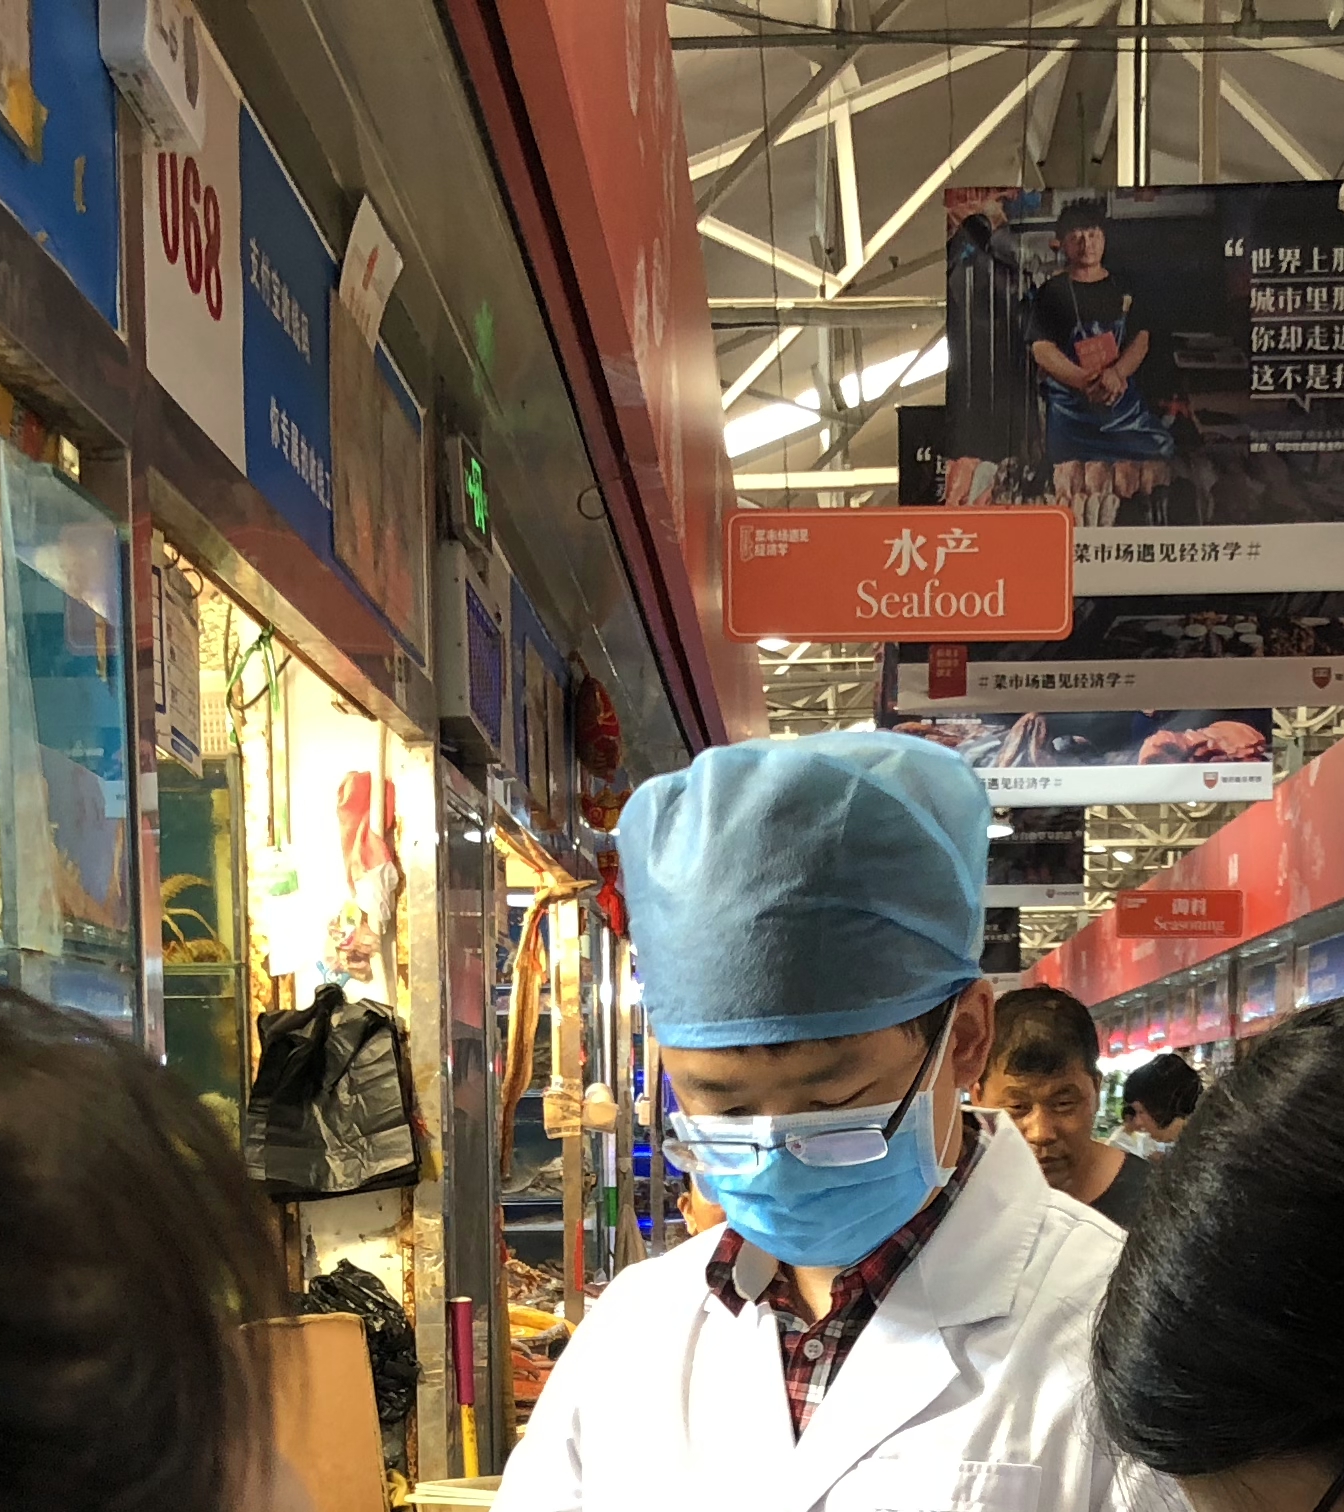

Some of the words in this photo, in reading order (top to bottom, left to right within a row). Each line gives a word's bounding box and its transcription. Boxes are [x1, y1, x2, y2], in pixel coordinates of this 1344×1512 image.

[158, 151, 223, 322] 068
[883, 528, 980, 577] 水产
[855, 578, 1006, 620] Seafood
